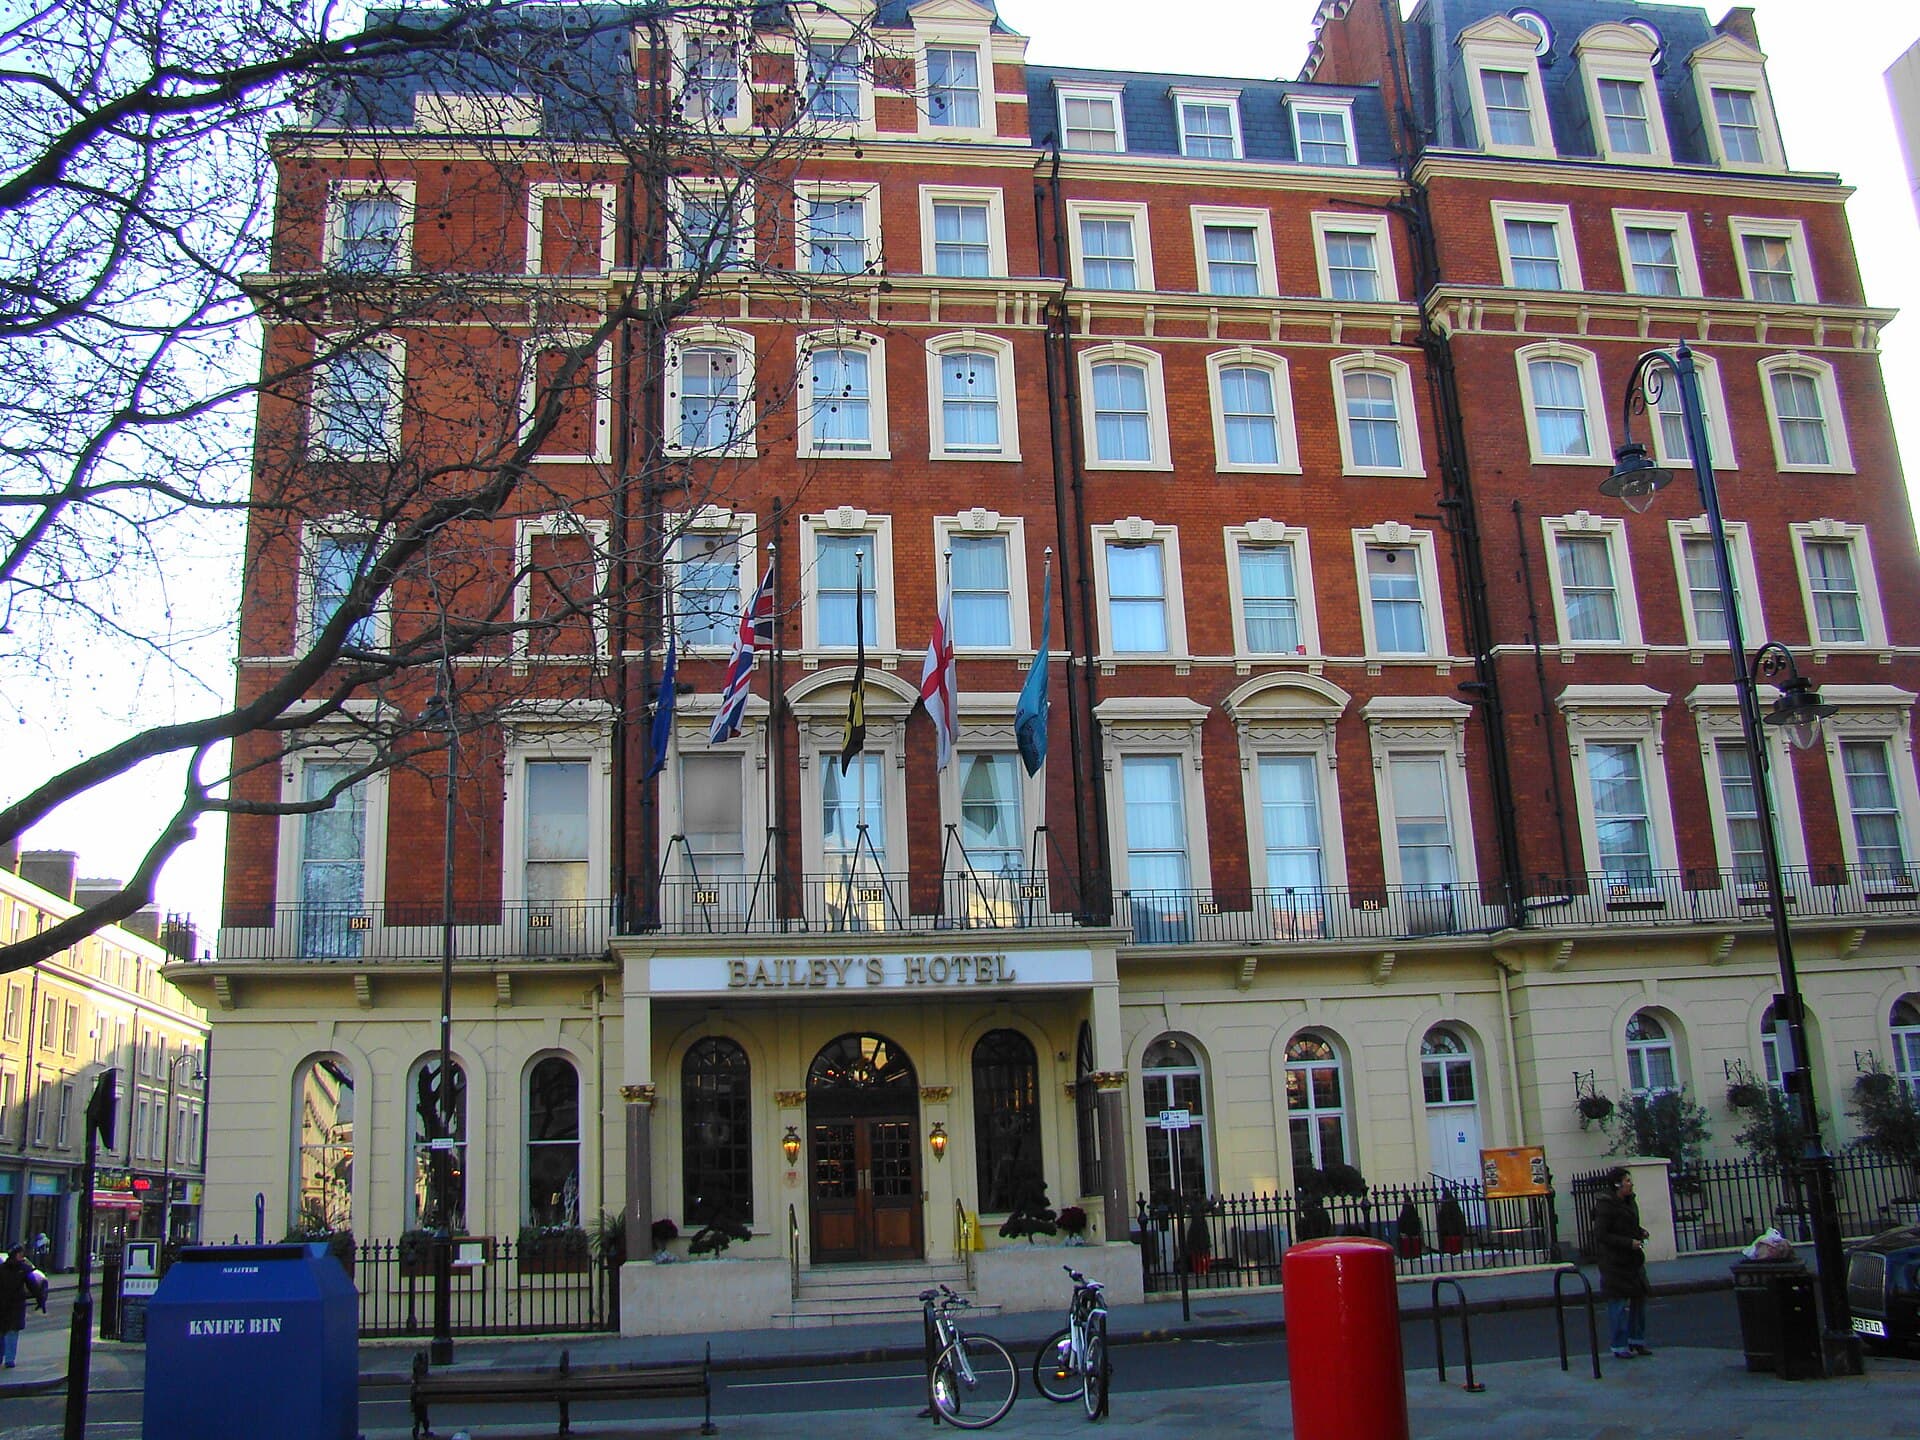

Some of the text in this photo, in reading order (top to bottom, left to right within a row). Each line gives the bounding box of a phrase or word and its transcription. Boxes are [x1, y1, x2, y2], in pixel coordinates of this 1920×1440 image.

[697, 891, 714, 902] BH
[862, 890, 880, 901] BH
[1025, 886, 1041, 897] BH
[1613, 886, 1627, 896] BH
[1203, 903, 1218, 914] BH
[1363, 900, 1379, 910] BH
[352, 918, 369, 929] BH
[532, 916, 549, 927] BH
[727, 955, 1016, 987] BAILEY'S HOTEL
[190, 1318, 282, 1335] KNIFE BIN
